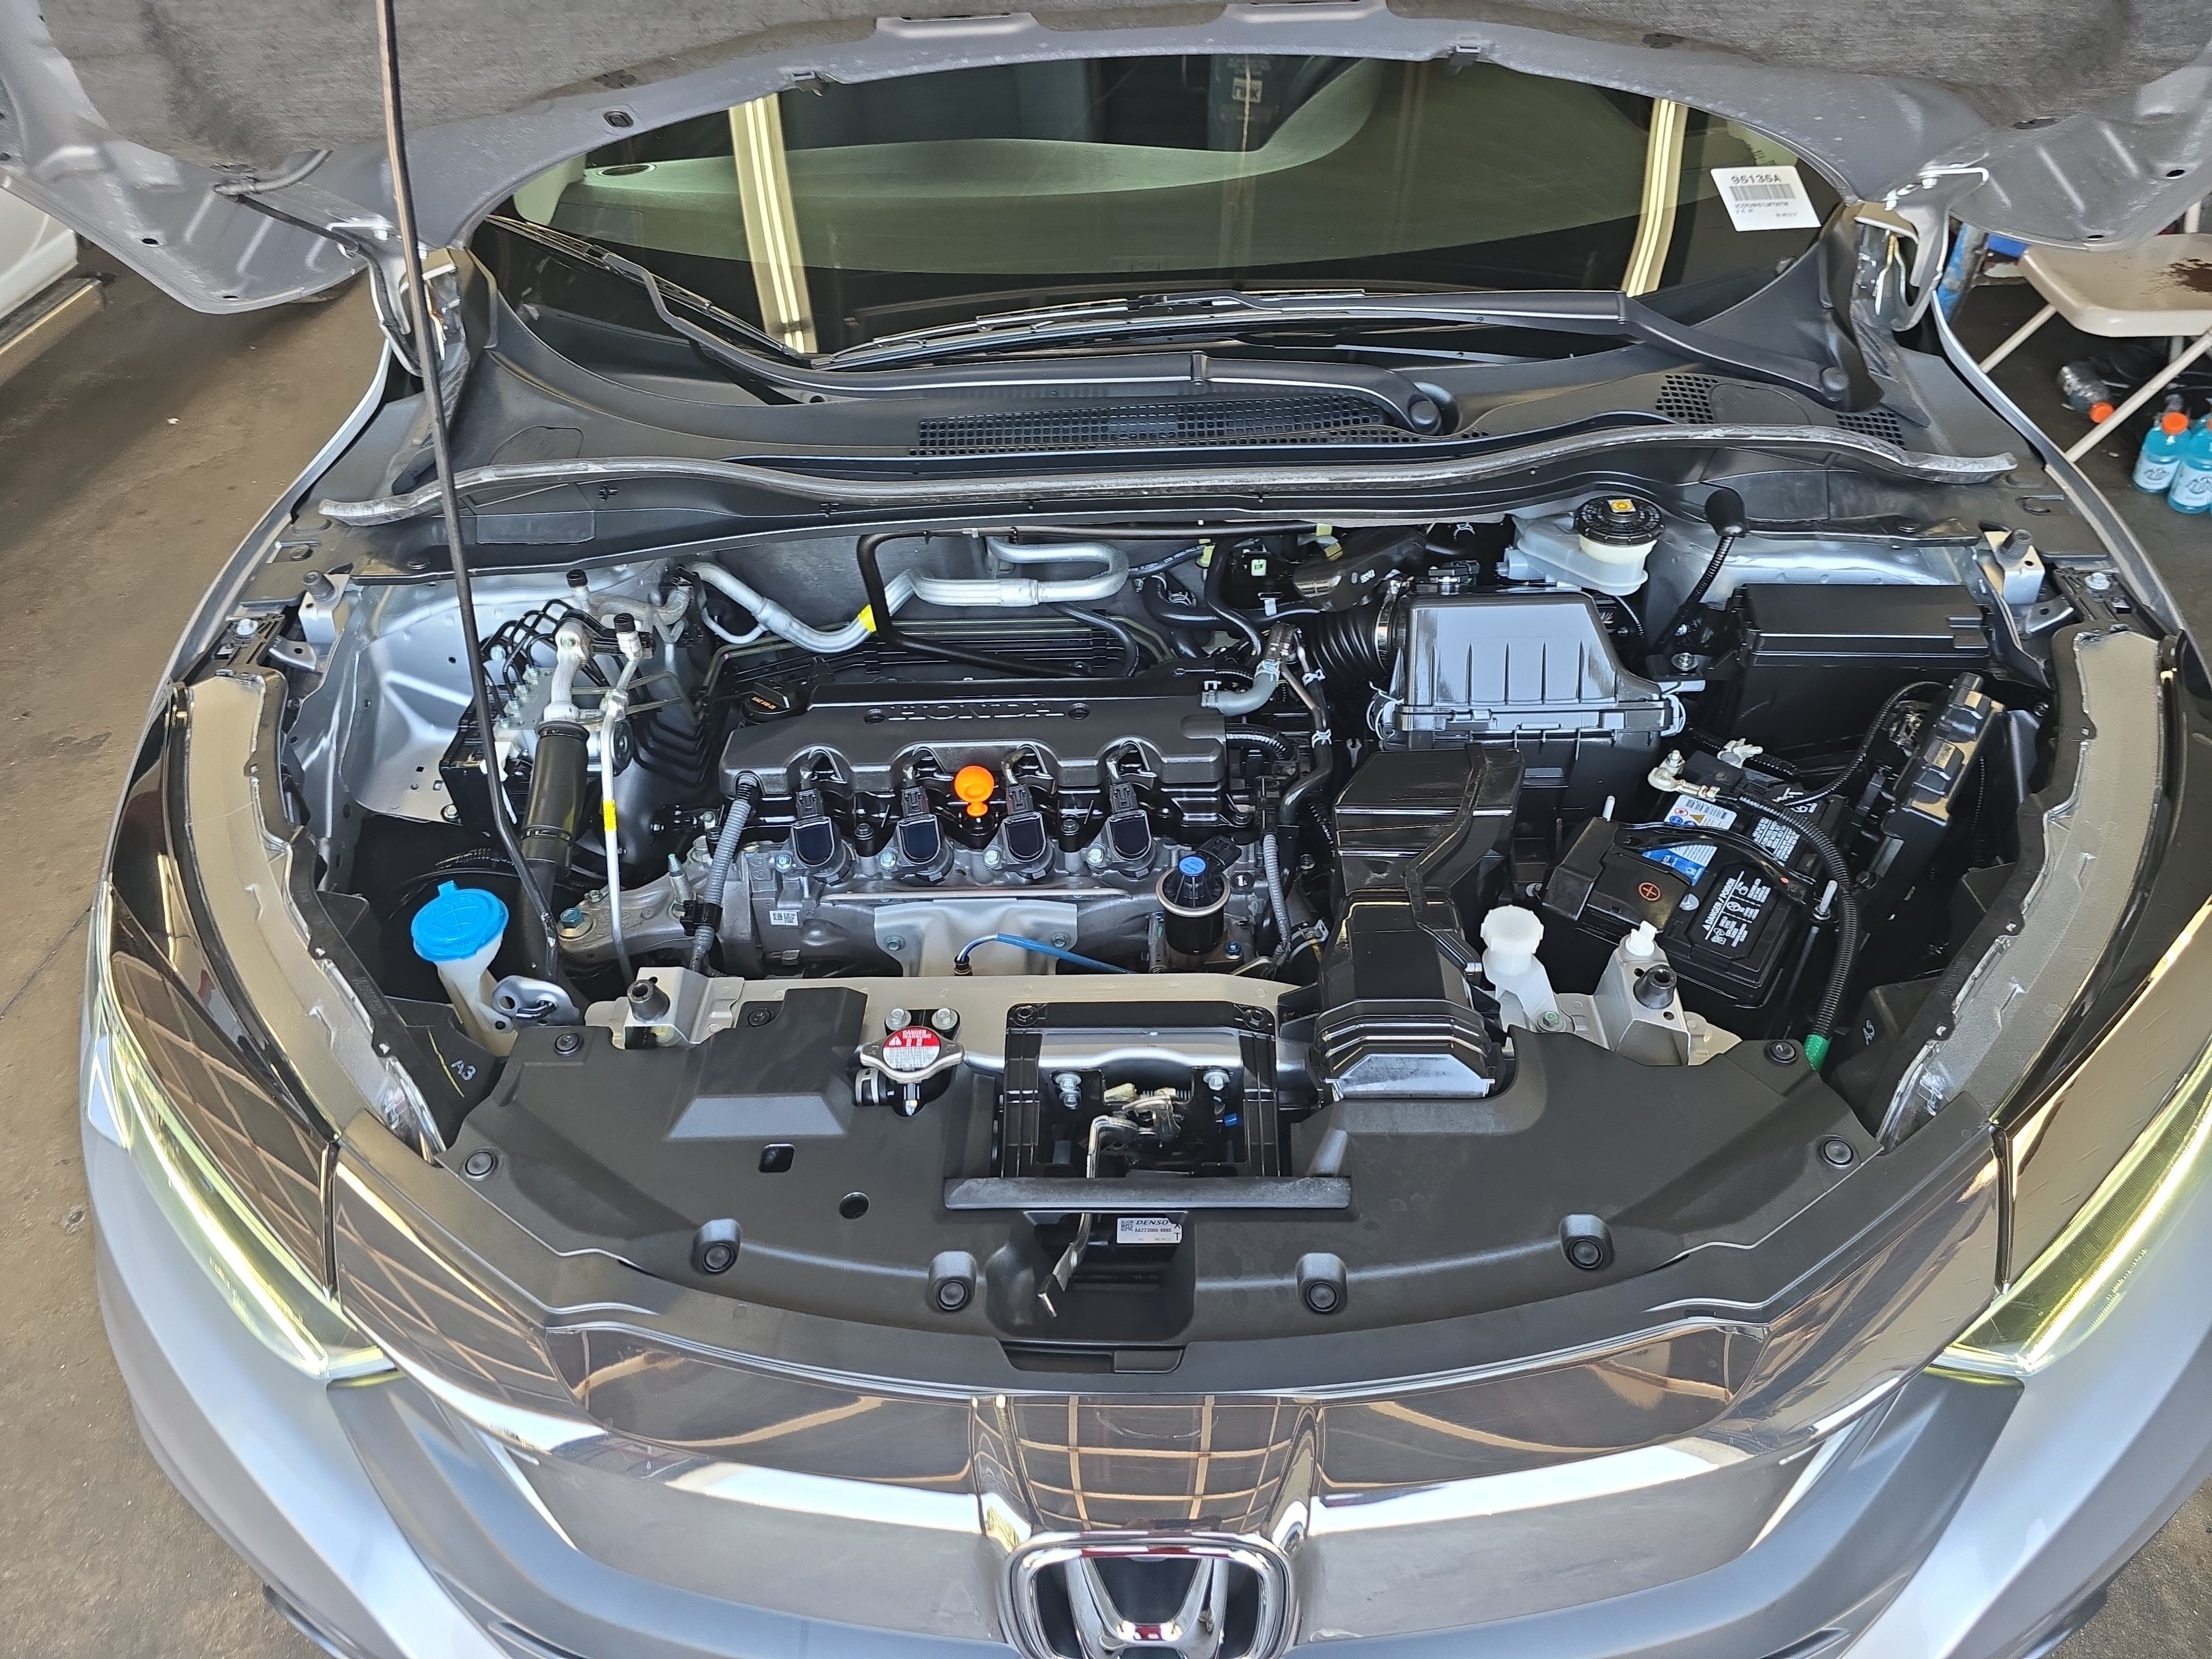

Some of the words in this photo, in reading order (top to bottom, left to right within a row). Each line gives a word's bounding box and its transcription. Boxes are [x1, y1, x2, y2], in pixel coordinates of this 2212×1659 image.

[888, 703, 1065, 721] HONDA
[1705, 902, 1722, 925] DANGER
[1719, 878, 1737, 898] POISON
[451, 1060, 476, 1081] A3
[1174, 1232, 1180, 1241] T
